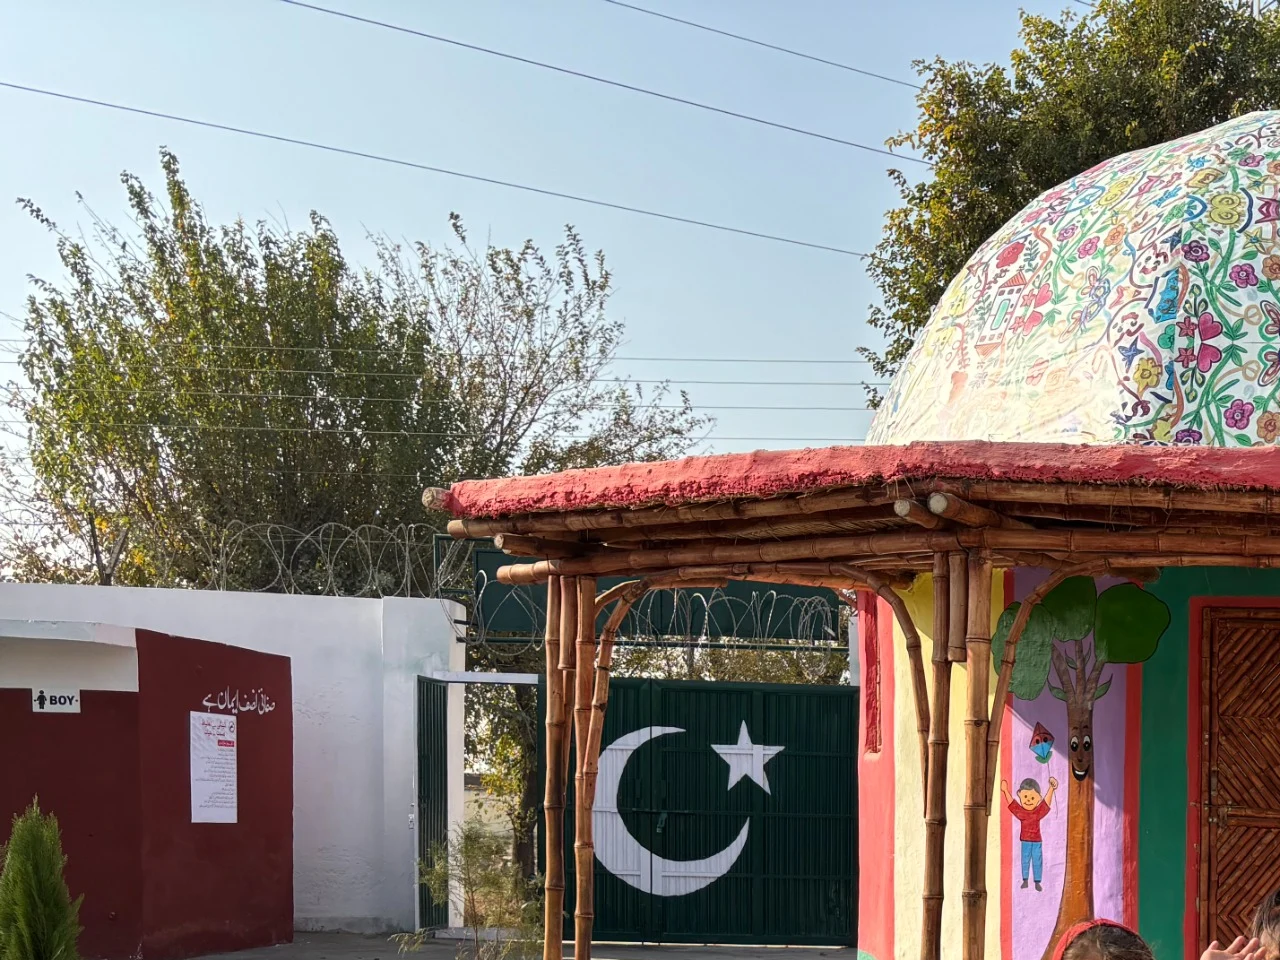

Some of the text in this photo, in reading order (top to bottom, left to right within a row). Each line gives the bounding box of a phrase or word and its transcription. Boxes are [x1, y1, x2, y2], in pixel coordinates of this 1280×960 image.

[49, 695, 75, 706] BOY
[202, 693, 219, 712] ہے
[217, 685, 239, 714] ایمان
[239, 689, 258, 711] نصف
